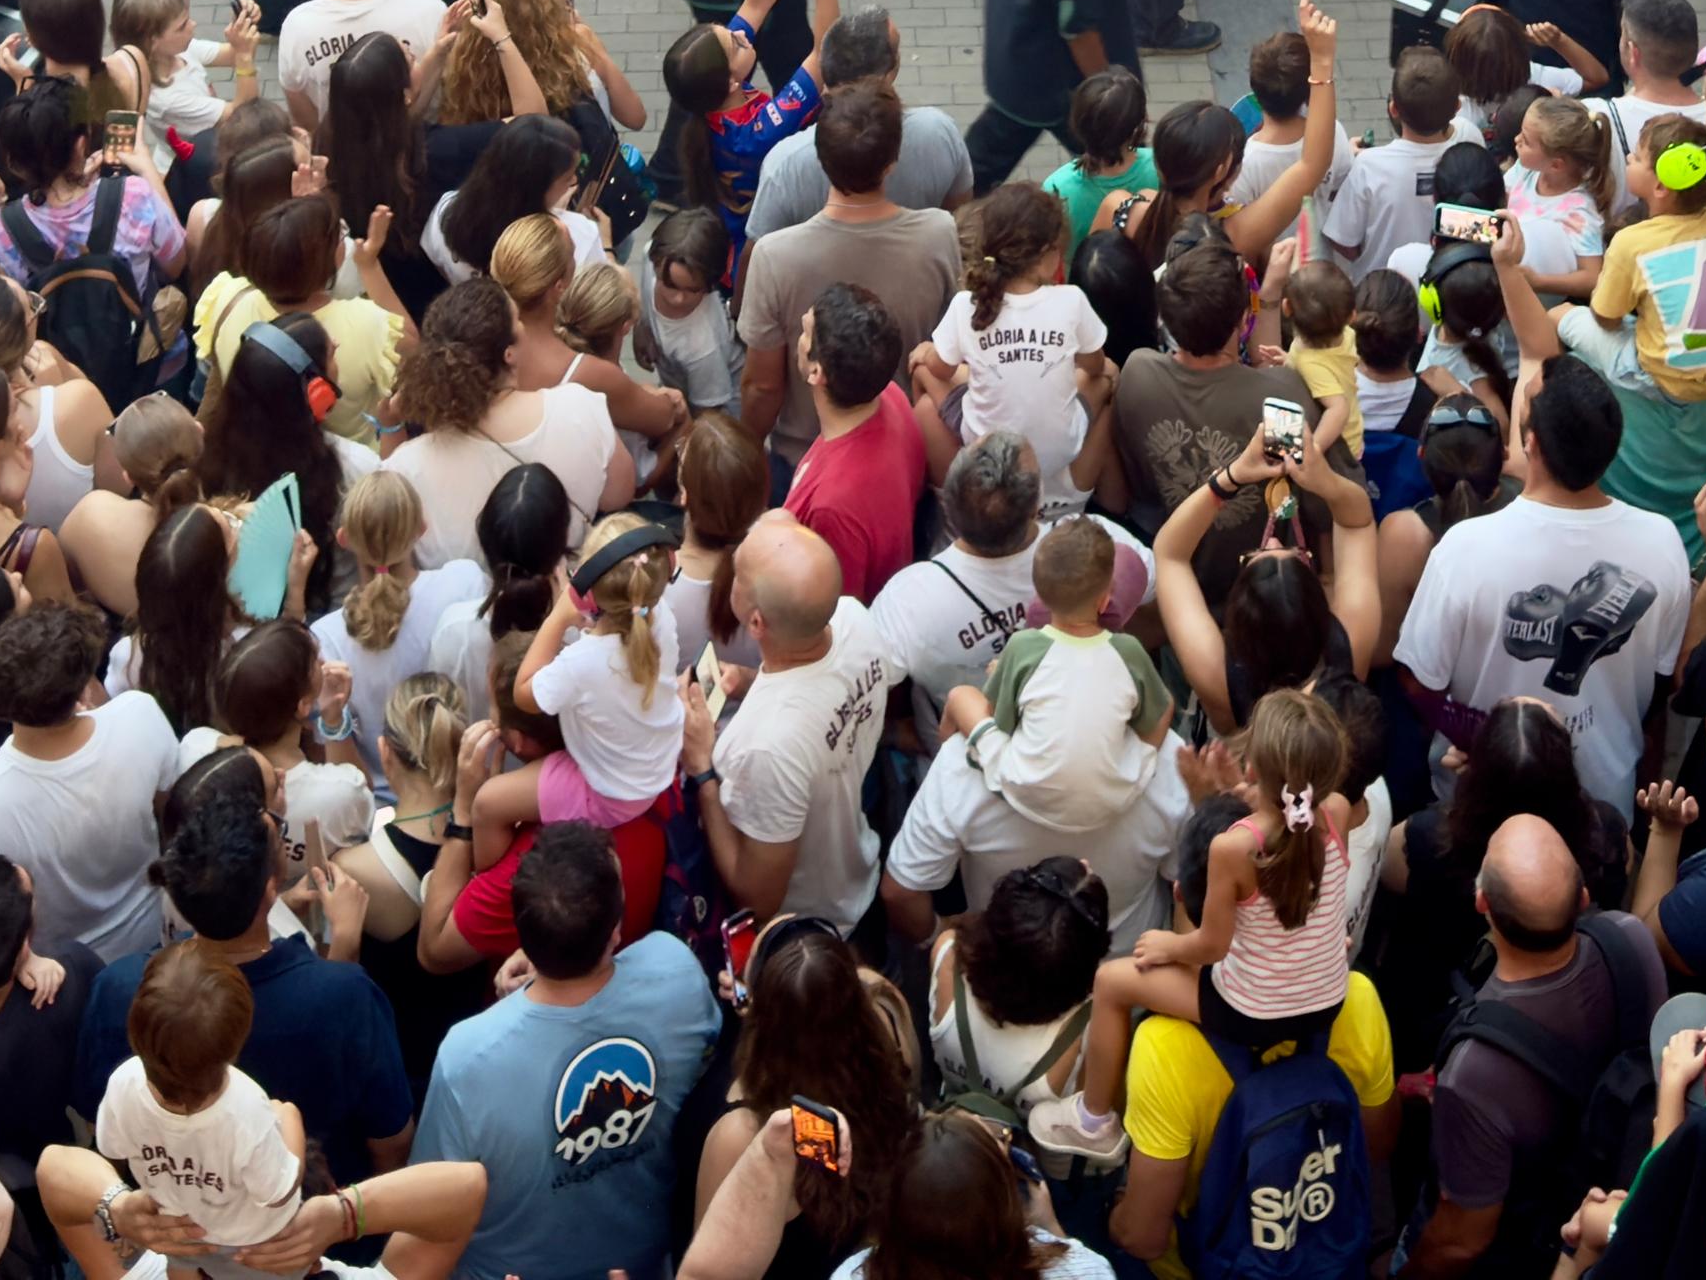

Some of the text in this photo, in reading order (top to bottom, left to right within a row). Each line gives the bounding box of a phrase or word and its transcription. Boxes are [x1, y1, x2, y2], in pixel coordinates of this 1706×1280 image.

[305, 31, 355, 66] GLÒRIA
[978, 327, 1065, 350] GLÒRIA A LES
[998, 348, 1043, 364] SANTES
[554, 1099, 656, 1166] 1987
